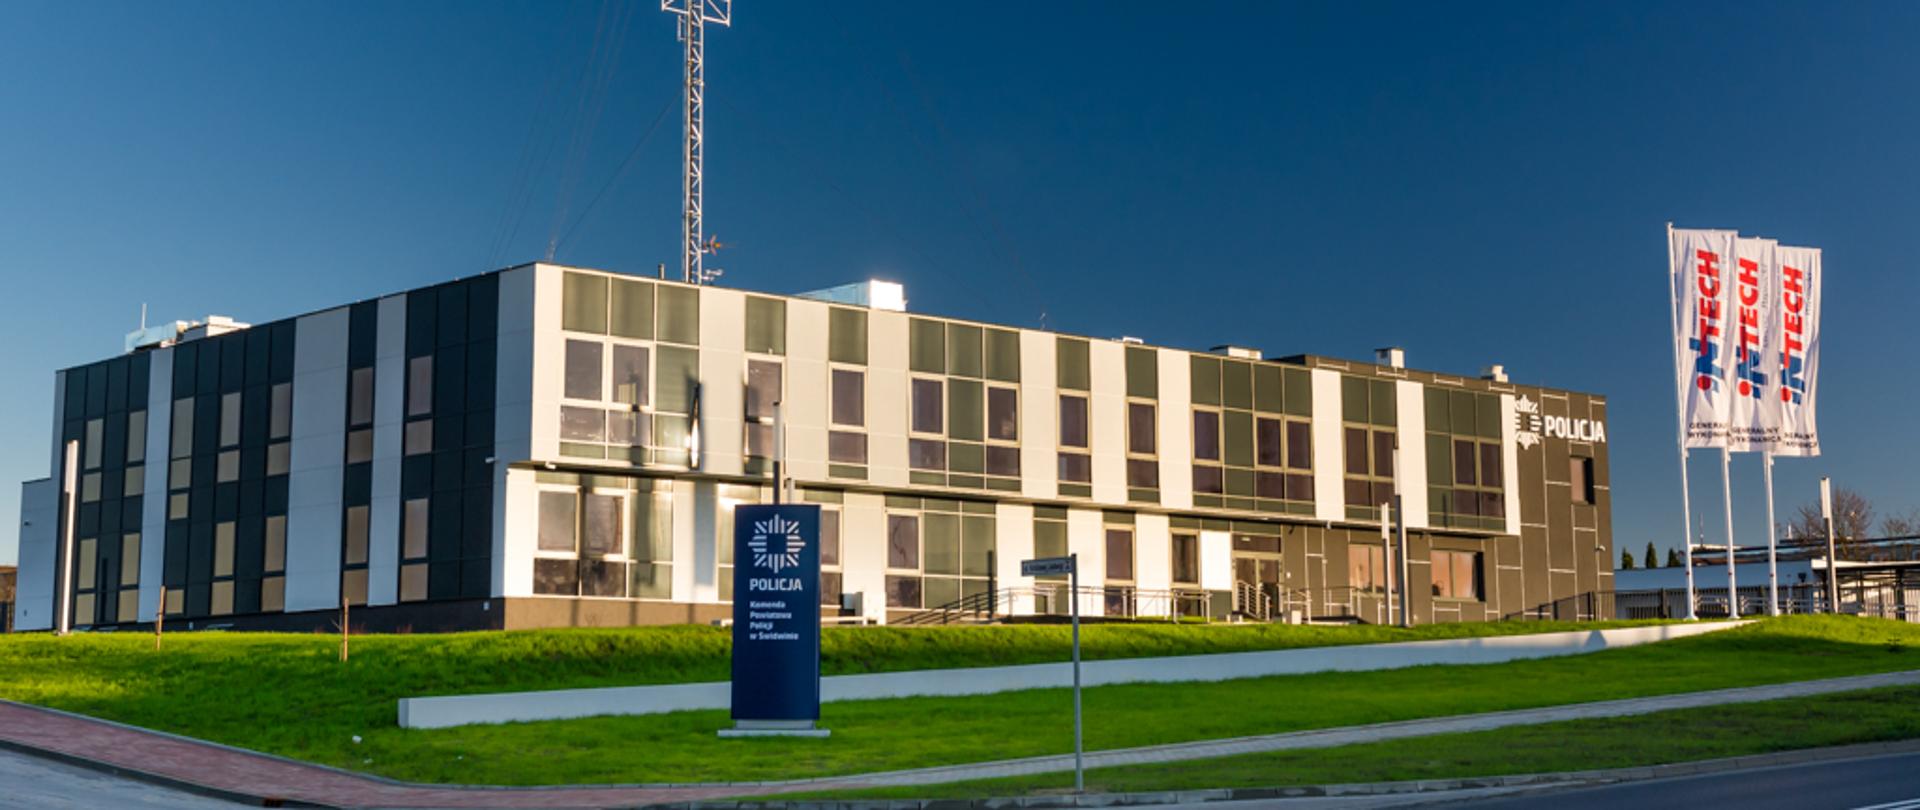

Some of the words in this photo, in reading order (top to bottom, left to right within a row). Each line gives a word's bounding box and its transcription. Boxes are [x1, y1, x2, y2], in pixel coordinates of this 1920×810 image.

[1544, 415, 1606, 443] POLICJA
[749, 578, 803, 591] POLICJA
[749, 600, 786, 609] Komenda
[749, 611, 792, 620] Powiatowa
[749, 621, 774, 631] Policji
